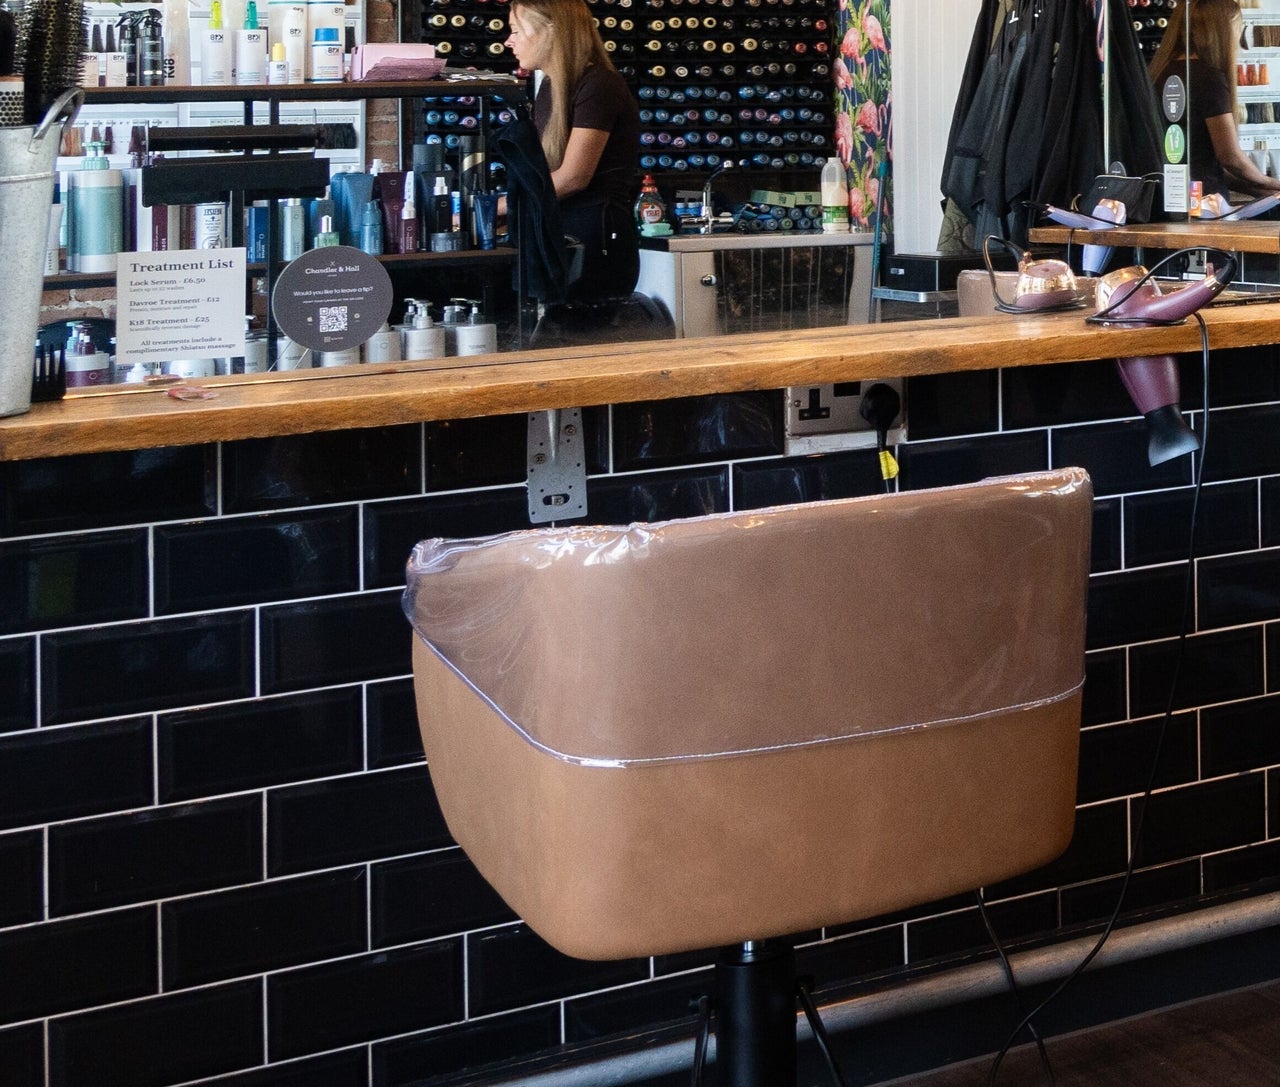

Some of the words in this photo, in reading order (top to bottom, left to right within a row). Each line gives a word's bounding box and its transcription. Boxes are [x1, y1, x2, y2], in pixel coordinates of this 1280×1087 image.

[130, 261, 204, 272] Treatment
[208, 259, 234, 269] List
[305, 266, 338, 275] Chandler
[129, 278, 149, 287] Lock
[150, 278, 177, 286] Serum
[183, 277, 206, 285] £6.50
[129, 299, 157, 307] Davroe
[147, 317, 188, 325] Treatment
[194, 316, 210, 324] £25
[126, 345, 179, 354] complimentary
[180, 343, 206, 352] Shiatsu
[207, 343, 236, 351] massage
